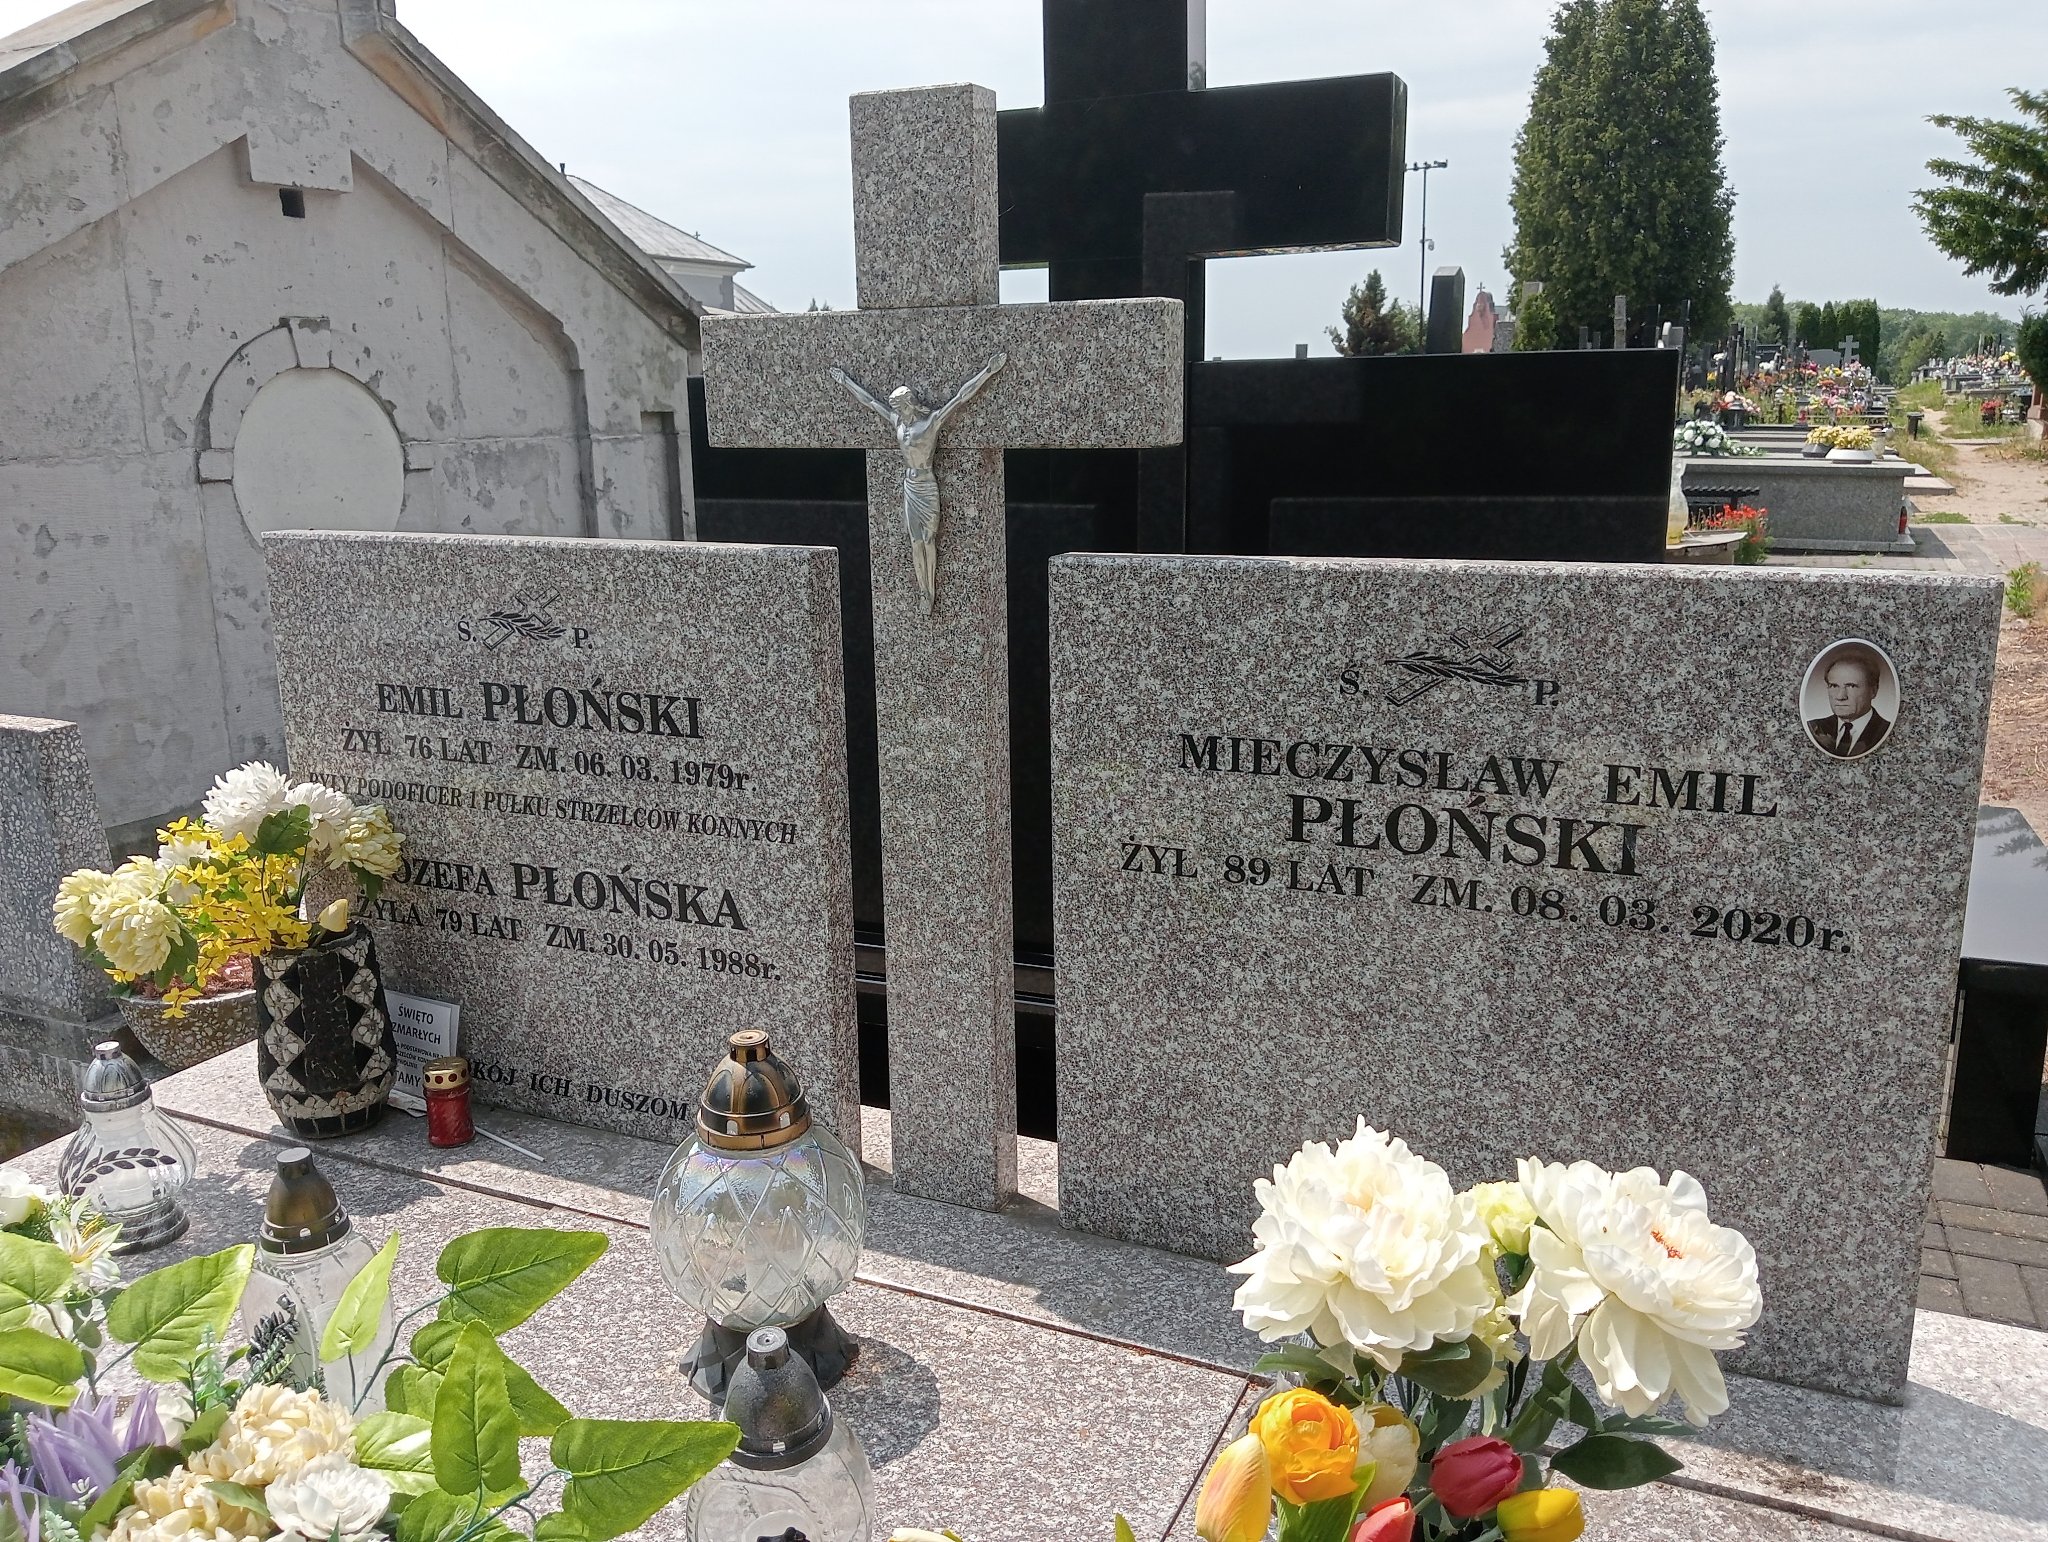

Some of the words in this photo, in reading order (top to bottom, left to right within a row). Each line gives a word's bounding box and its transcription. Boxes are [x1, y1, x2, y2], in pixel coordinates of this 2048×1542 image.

[457, 614, 477, 643] Ś.
[571, 627, 593, 650] P.
[377, 683, 463, 719] EMIL
[479, 678, 704, 739] PŁOŃSKI
[1339, 664, 1370, 696] Ś.
[1533, 679, 1561, 706] P.
[341, 721, 391, 755] ŻYŁ
[404, 734, 433, 760] 76
[440, 737, 493, 765] LAT
[515, 744, 567, 773] ZM.
[574, 750, 612, 778] 06.
[620, 755, 660, 783] 03.
[670, 760, 757, 792] 1979r.
[1178, 733, 1564, 799] MIECZYSŁAW
[1603, 763, 1778, 818] EMIL
[357, 777, 463, 808] PODOFICER
[469, 790, 477, 809] 1
[484, 790, 550, 818] PUŁKU
[555, 799, 680, 832] STRZELCÓW
[687, 811, 798, 844] KONNYCH
[1285, 793, 1650, 877] PŁOŃSKI
[393, 856, 498, 896] ZEFA
[510, 862, 748, 931] PŁOŃSKA
[1121, 835, 1199, 879] ŻYŁ
[1223, 855, 1271, 886] 89
[1286, 859, 1375, 898] LAT
[1411, 873, 1493, 913] ZM.
[1511, 885, 1579, 923] 08.
[1600, 894, 1670, 934] 03.
[1690, 904, 1852, 954] 2020r.
[436, 907, 463, 933] 79
[470, 911, 523, 942] LAT
[545, 923, 596, 954] ZM.
[603, 932, 640, 960] 30.
[649, 939, 687, 968] 05.
[697, 946, 782, 981] 1988r.
[391, 1022, 441, 1045] ZMARŁYCH
[398, 1003, 434, 1025] ŚWIĘTO
[468, 1059, 518, 1087] KÓJ
[529, 1073, 573, 1099] ICH
[586, 1083, 689, 1121] DUSZOM
